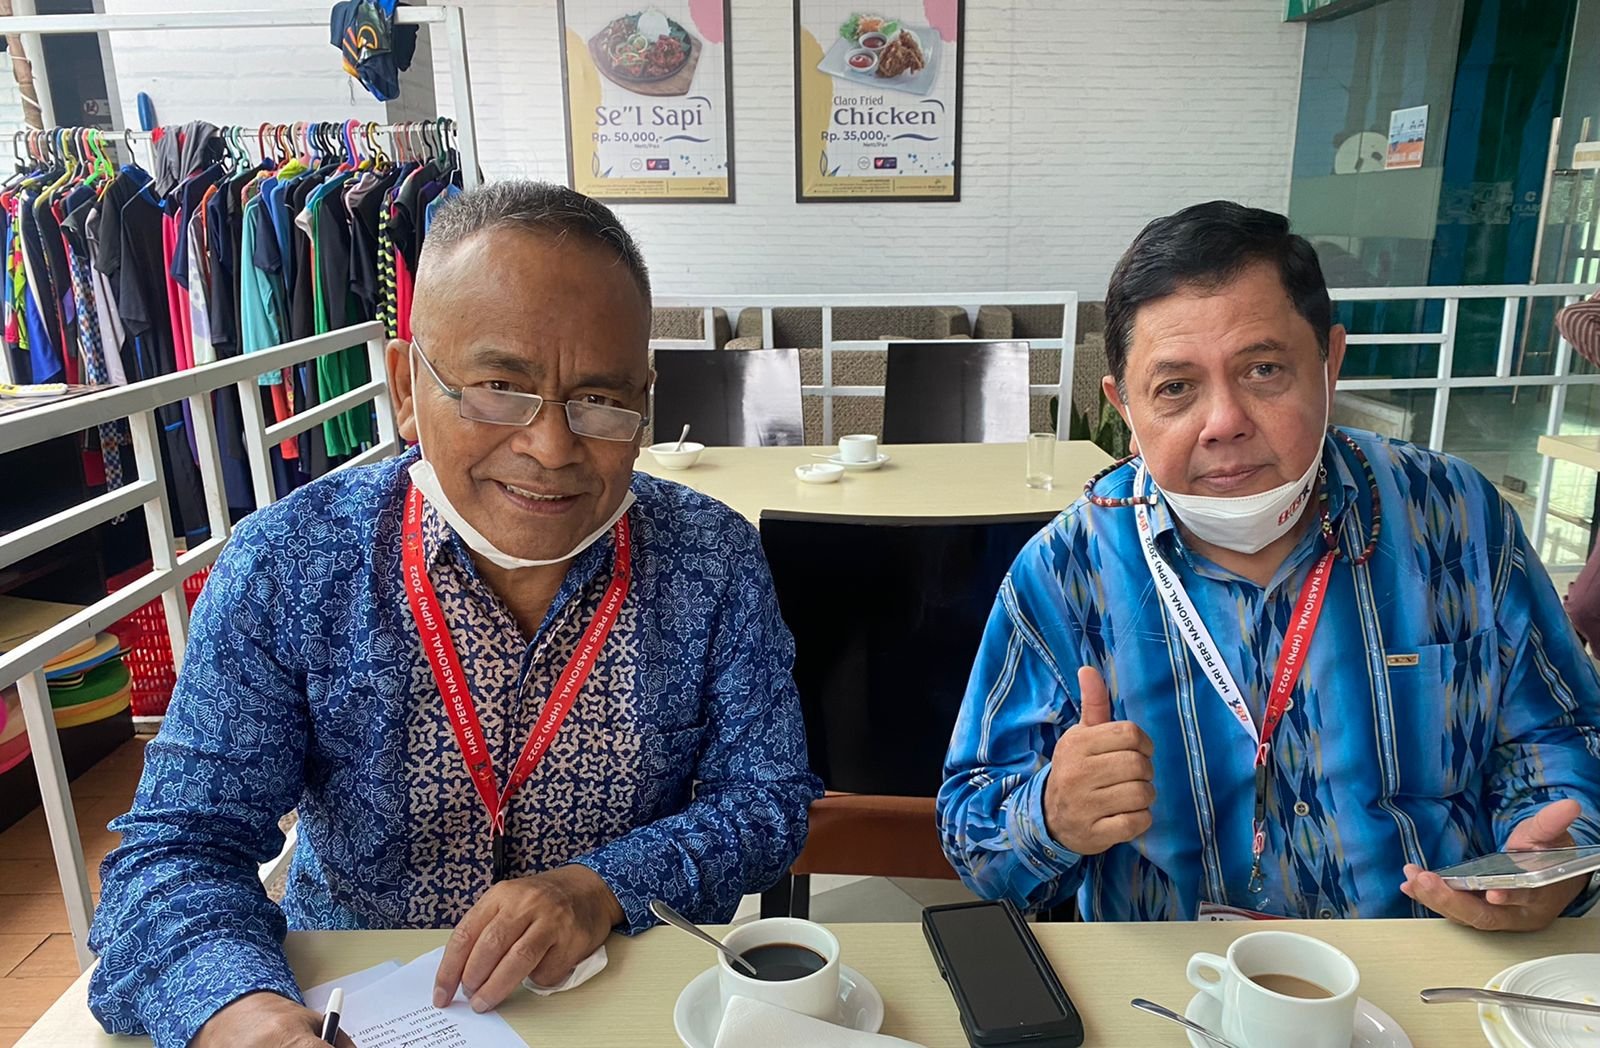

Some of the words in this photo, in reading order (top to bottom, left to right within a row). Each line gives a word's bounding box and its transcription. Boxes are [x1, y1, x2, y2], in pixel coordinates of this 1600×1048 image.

[834, 96, 857, 106] Claro
[860, 96, 883, 106] Fried
[652, 104, 703, 130] Sapi
[834, 107, 936, 126] Chicken
[592, 132, 611, 144] Rp.
[821, 131, 840, 143] Rp.
[408, 482, 418, 524] SULAW
[617, 516, 625, 547] GARA
[1145, 536, 1158, 560] 2022
[1154, 560, 1173, 589] (HPN)
[1314, 552, 1331, 575] ERS
[410, 564, 424, 593] 2022
[418, 596, 438, 631] (HPN)
[605, 586, 622, 614] HARI
[1296, 576, 1321, 632] NASIONAL
[590, 615, 608, 644] PERS
[1169, 590, 1201, 642] NASIONAL
[431, 632, 459, 694] NASIONAL
[1196, 643, 1216, 668] PERS
[1285, 634, 1304, 666] (HPN)
[559, 644, 593, 700] NASIONAL
[1212, 669, 1230, 694] HARI
[1277, 666, 1293, 694] 2022
[452, 696, 470, 725] PERS
[541, 702, 563, 734] (HPN)
[462, 726, 479, 755] HARI
[526, 735, 545, 762] 2022
[360, 1024, 384, 1035] hadir
[409, 1011, 442, 1026] namun
[425, 1018, 448, 1029] akan
[362, 1029, 396, 1043] karena
